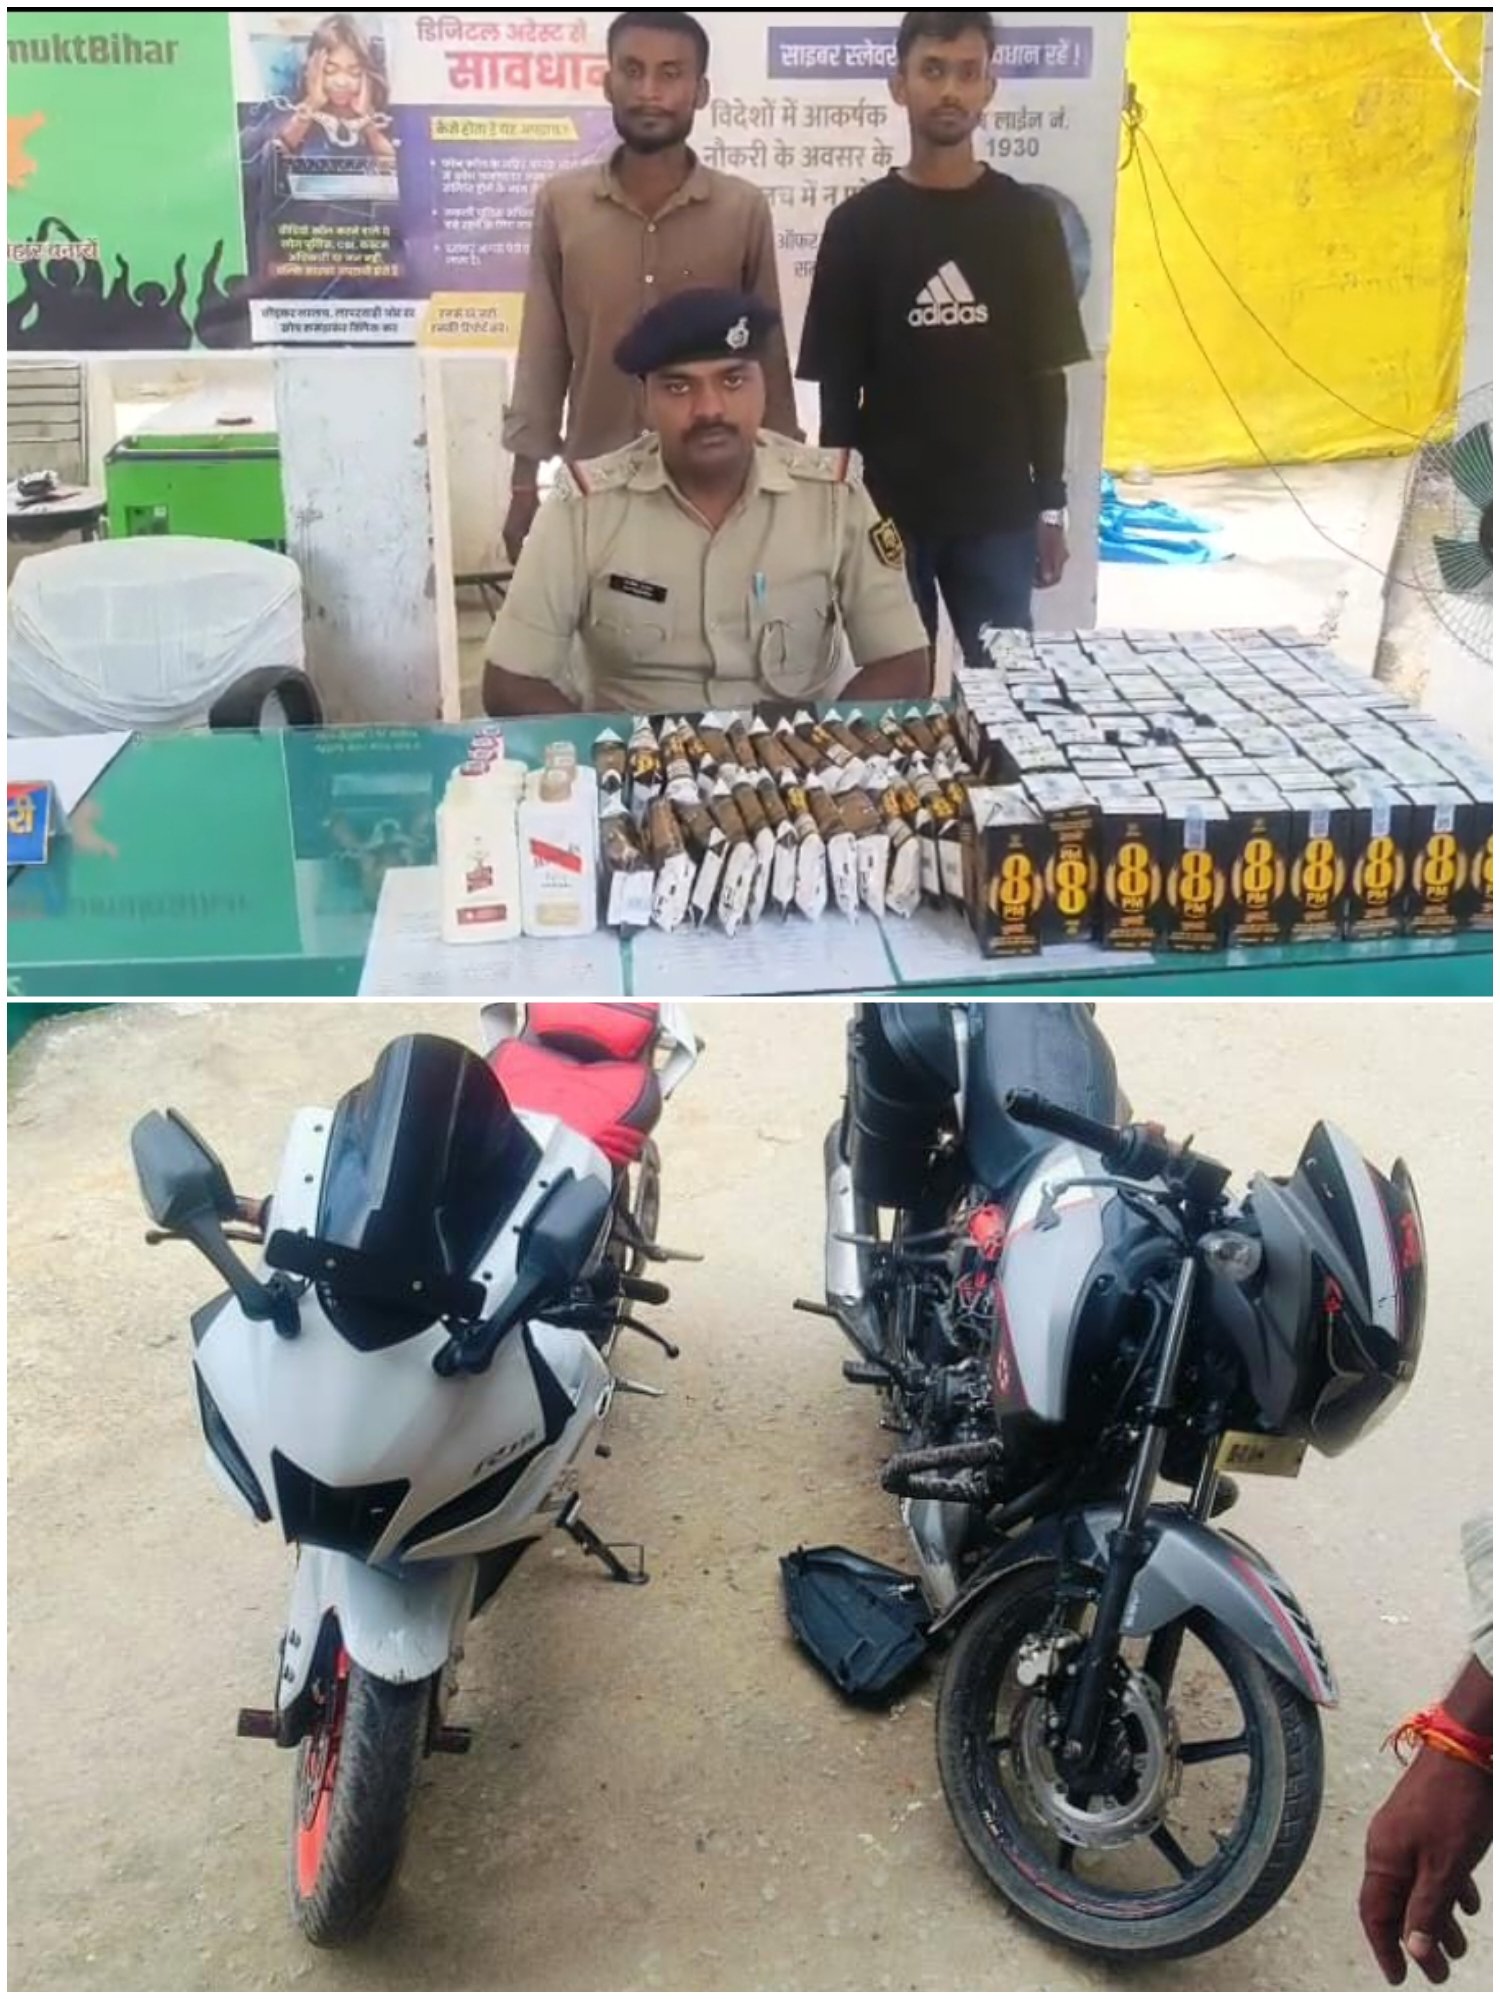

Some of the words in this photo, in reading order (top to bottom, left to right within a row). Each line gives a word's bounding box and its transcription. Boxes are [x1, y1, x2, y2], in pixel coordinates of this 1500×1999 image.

[416, 16, 500, 42] डिजिटल
[506, 18, 564, 43] अरेस्ट
[569, 17, 588, 43] से
[779, 43, 841, 67] साइबर
[710, 96, 776, 129] विदेशों
[780, 96, 797, 127] में
[802, 97, 888, 127] आकर्षक
[703, 136, 768, 168] नौकरी
[773, 138, 796, 167] के
[801, 145, 866, 168] अवसर
[872, 136, 895, 168] के
[986, 137, 1040, 157] 1930
[802, 178, 816, 207] में
[908, 302, 989, 327] adidas
[1000, 853, 1031, 904] 8
[1117, 843, 1149, 896] 8
[1180, 850, 1212, 902] 8
[1243, 839, 1273, 891] 8
[1303, 838, 1334, 891] 8
[1364, 837, 1394, 888] 8
[1424, 833, 1456, 886] 8
[1056, 861, 1087, 914] 8
